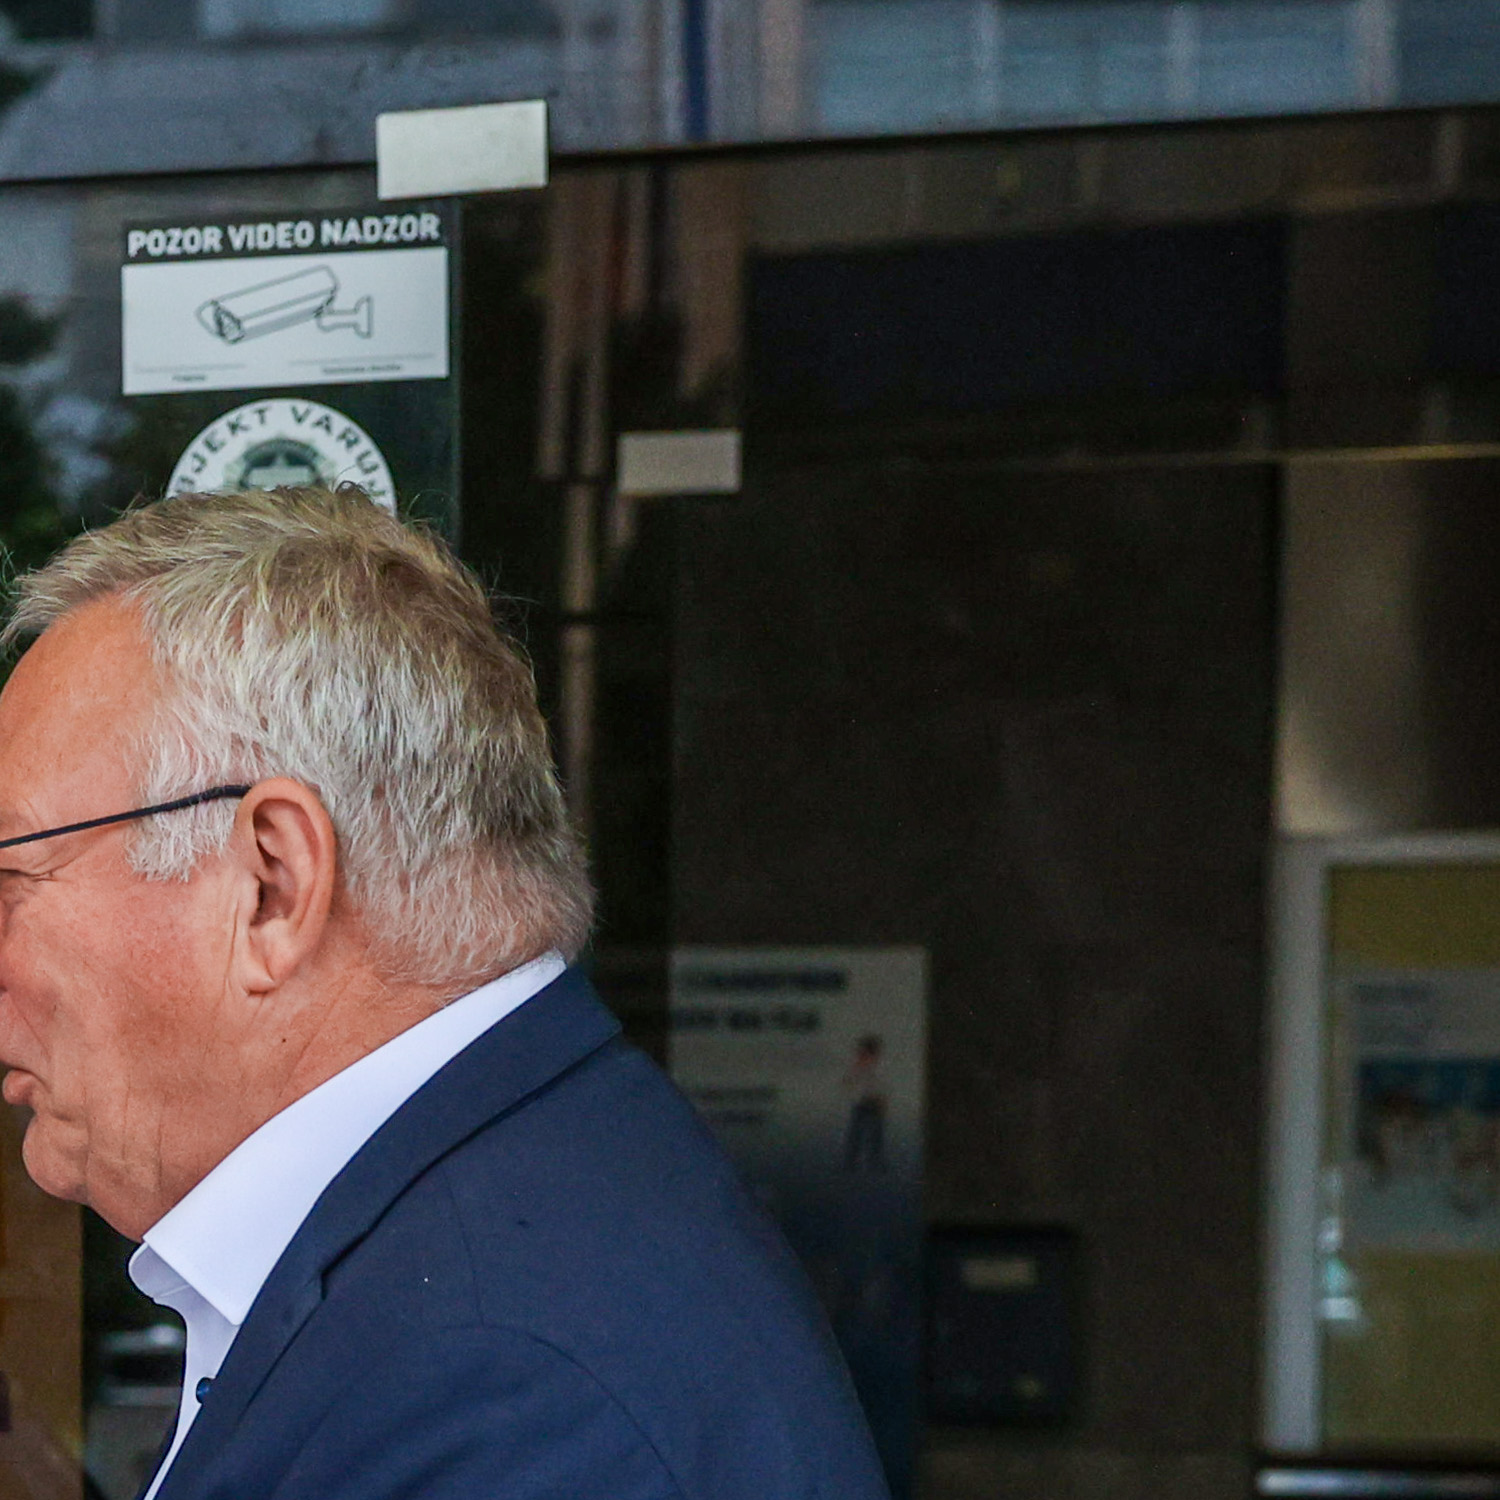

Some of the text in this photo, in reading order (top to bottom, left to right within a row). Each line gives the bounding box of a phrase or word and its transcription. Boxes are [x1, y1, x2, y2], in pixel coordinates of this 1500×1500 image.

[129, 213, 441, 256] POZOR VIDEO NADZOR
